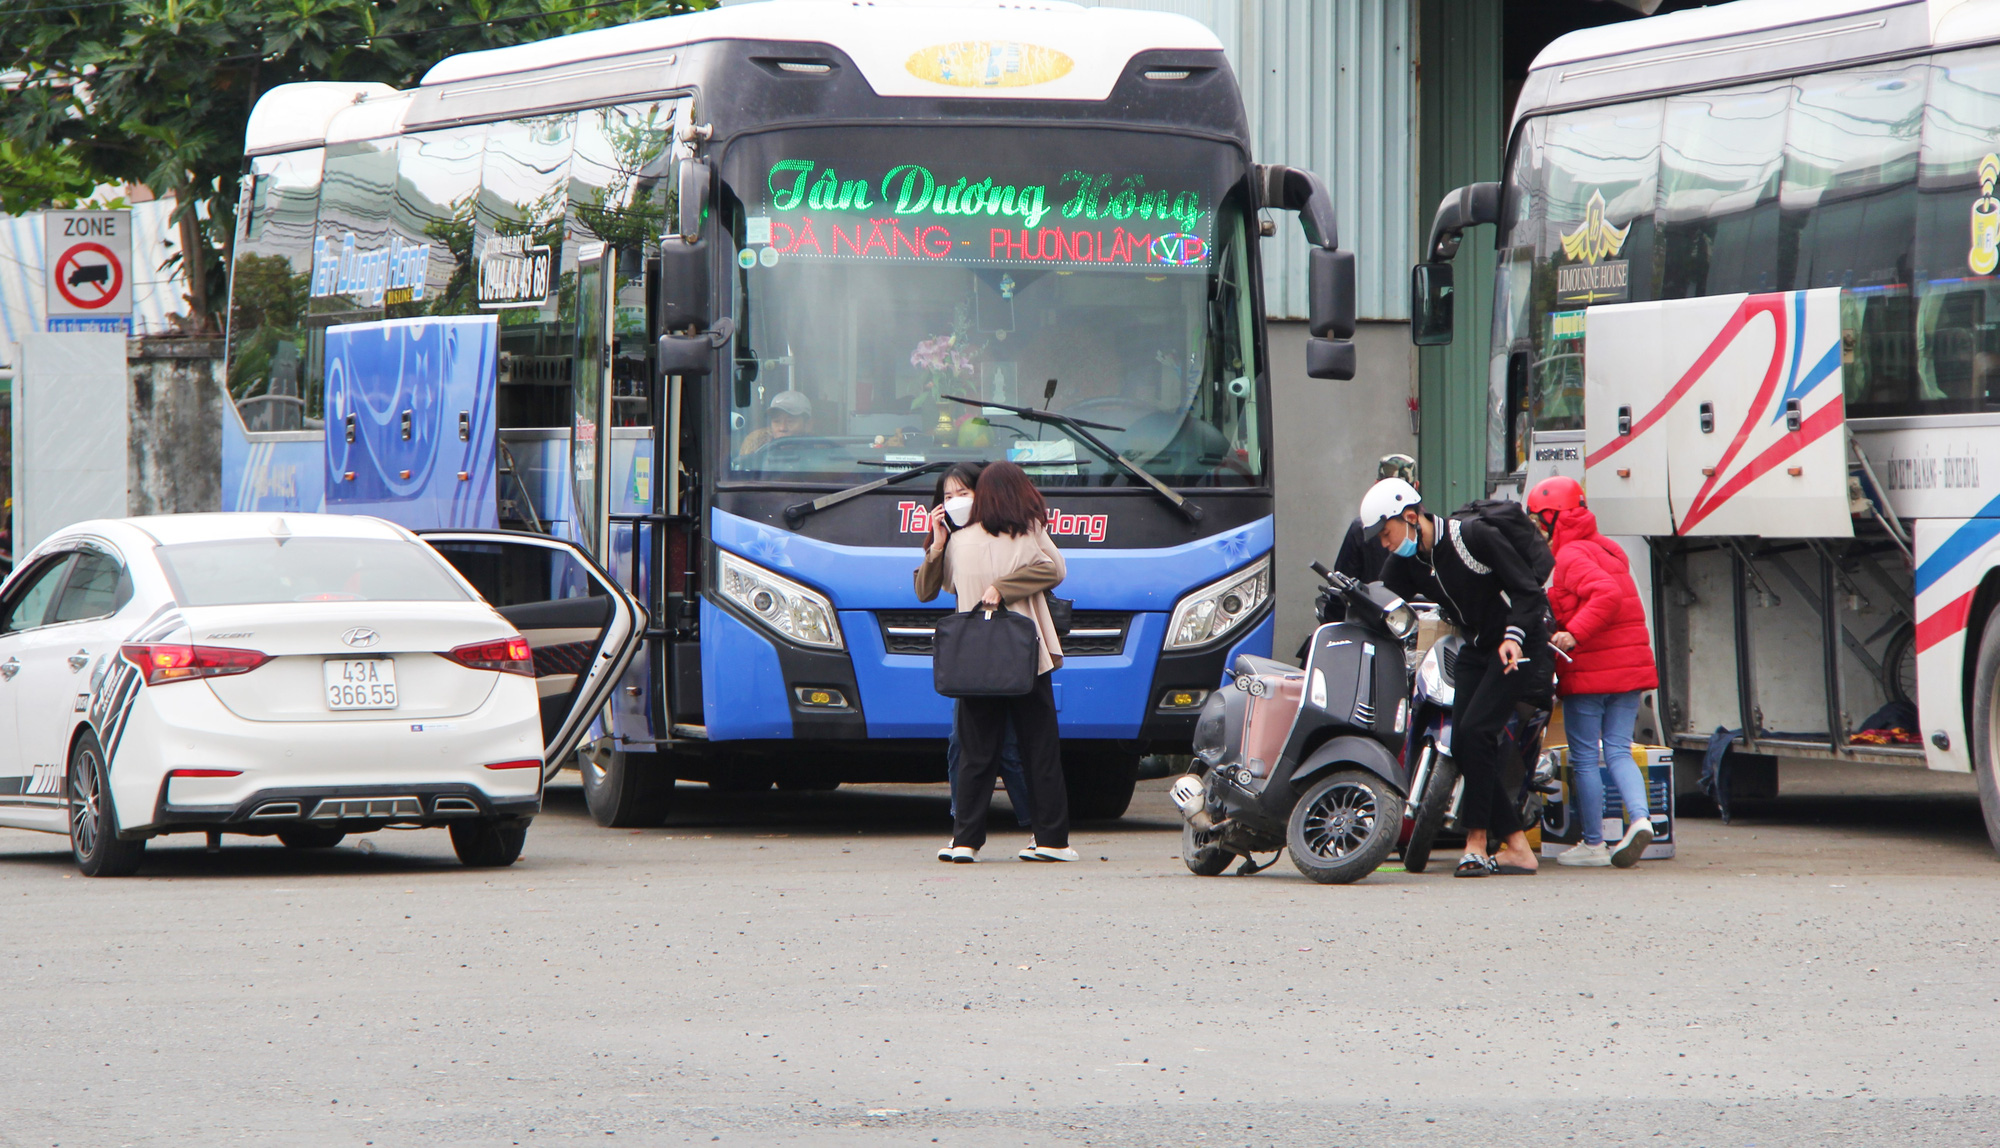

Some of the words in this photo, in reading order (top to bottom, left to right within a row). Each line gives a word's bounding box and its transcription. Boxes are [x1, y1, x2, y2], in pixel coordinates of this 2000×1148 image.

[768, 159, 873, 211] Tân
[882, 164, 1051, 229] Dương
[64, 217, 116, 236] ZONE
[770, 216, 823, 254] ĐÀ
[1098, 226, 1151, 263] LÂM
[1160, 235, 1203, 262] VIP
[310, 235, 340, 298] Tân
[533, 255, 547, 298] 68
[1558, 264, 1599, 293] LIMOUSINE
[1600, 263, 1628, 289] HOUSE
[1047, 508, 1109, 543] Hong
[205, 631, 255, 641] ACCENT
[341, 661, 380, 684] 43A
[328, 683, 396, 707] 366.55
